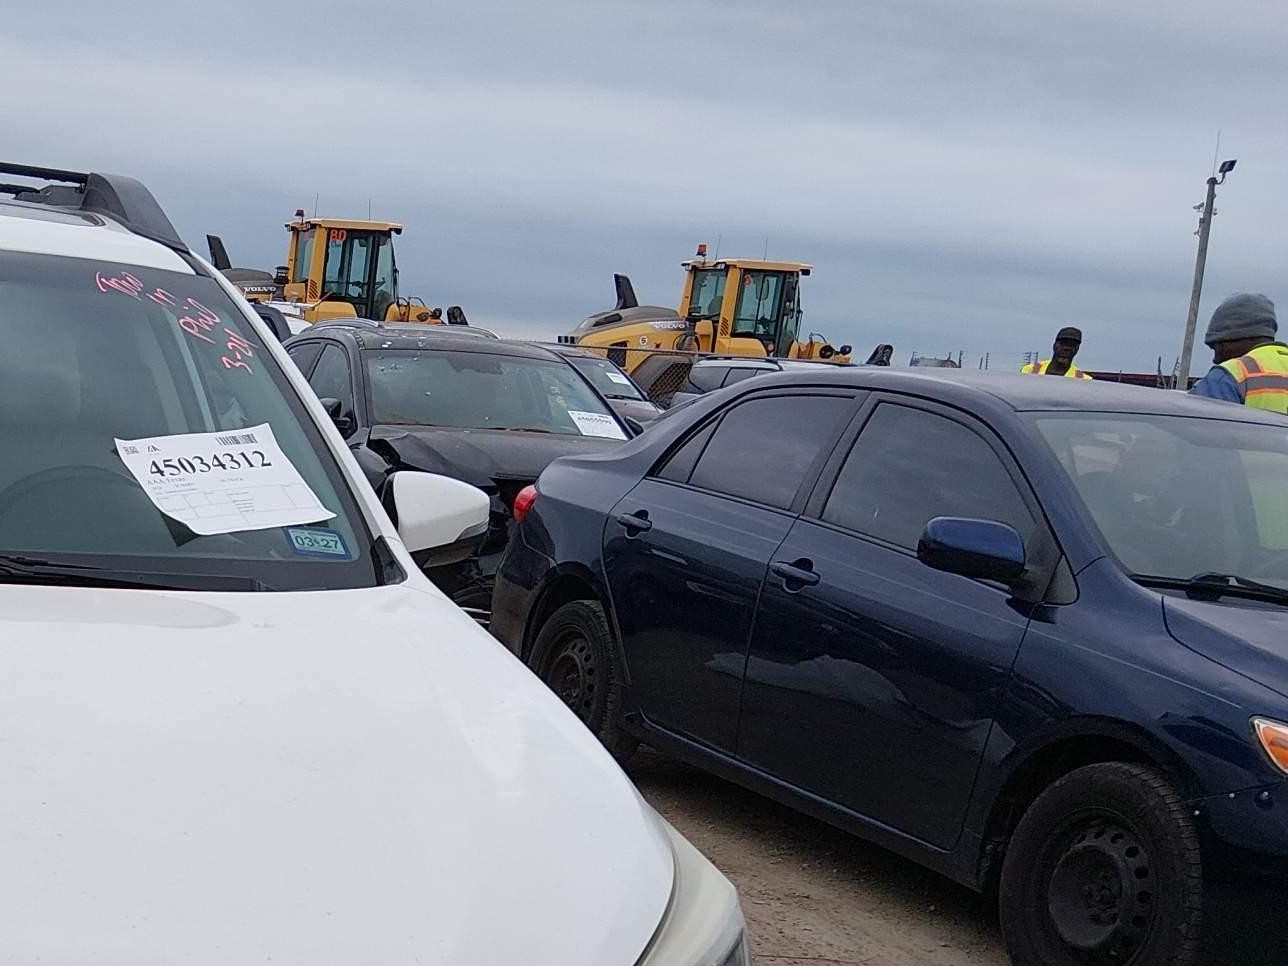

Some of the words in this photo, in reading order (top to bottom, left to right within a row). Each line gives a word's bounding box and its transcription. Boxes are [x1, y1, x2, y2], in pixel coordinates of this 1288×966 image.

[149, 450, 272, 477] 45034312
[295, 535, 314, 547] 03
[320, 538, 338, 549] 27
